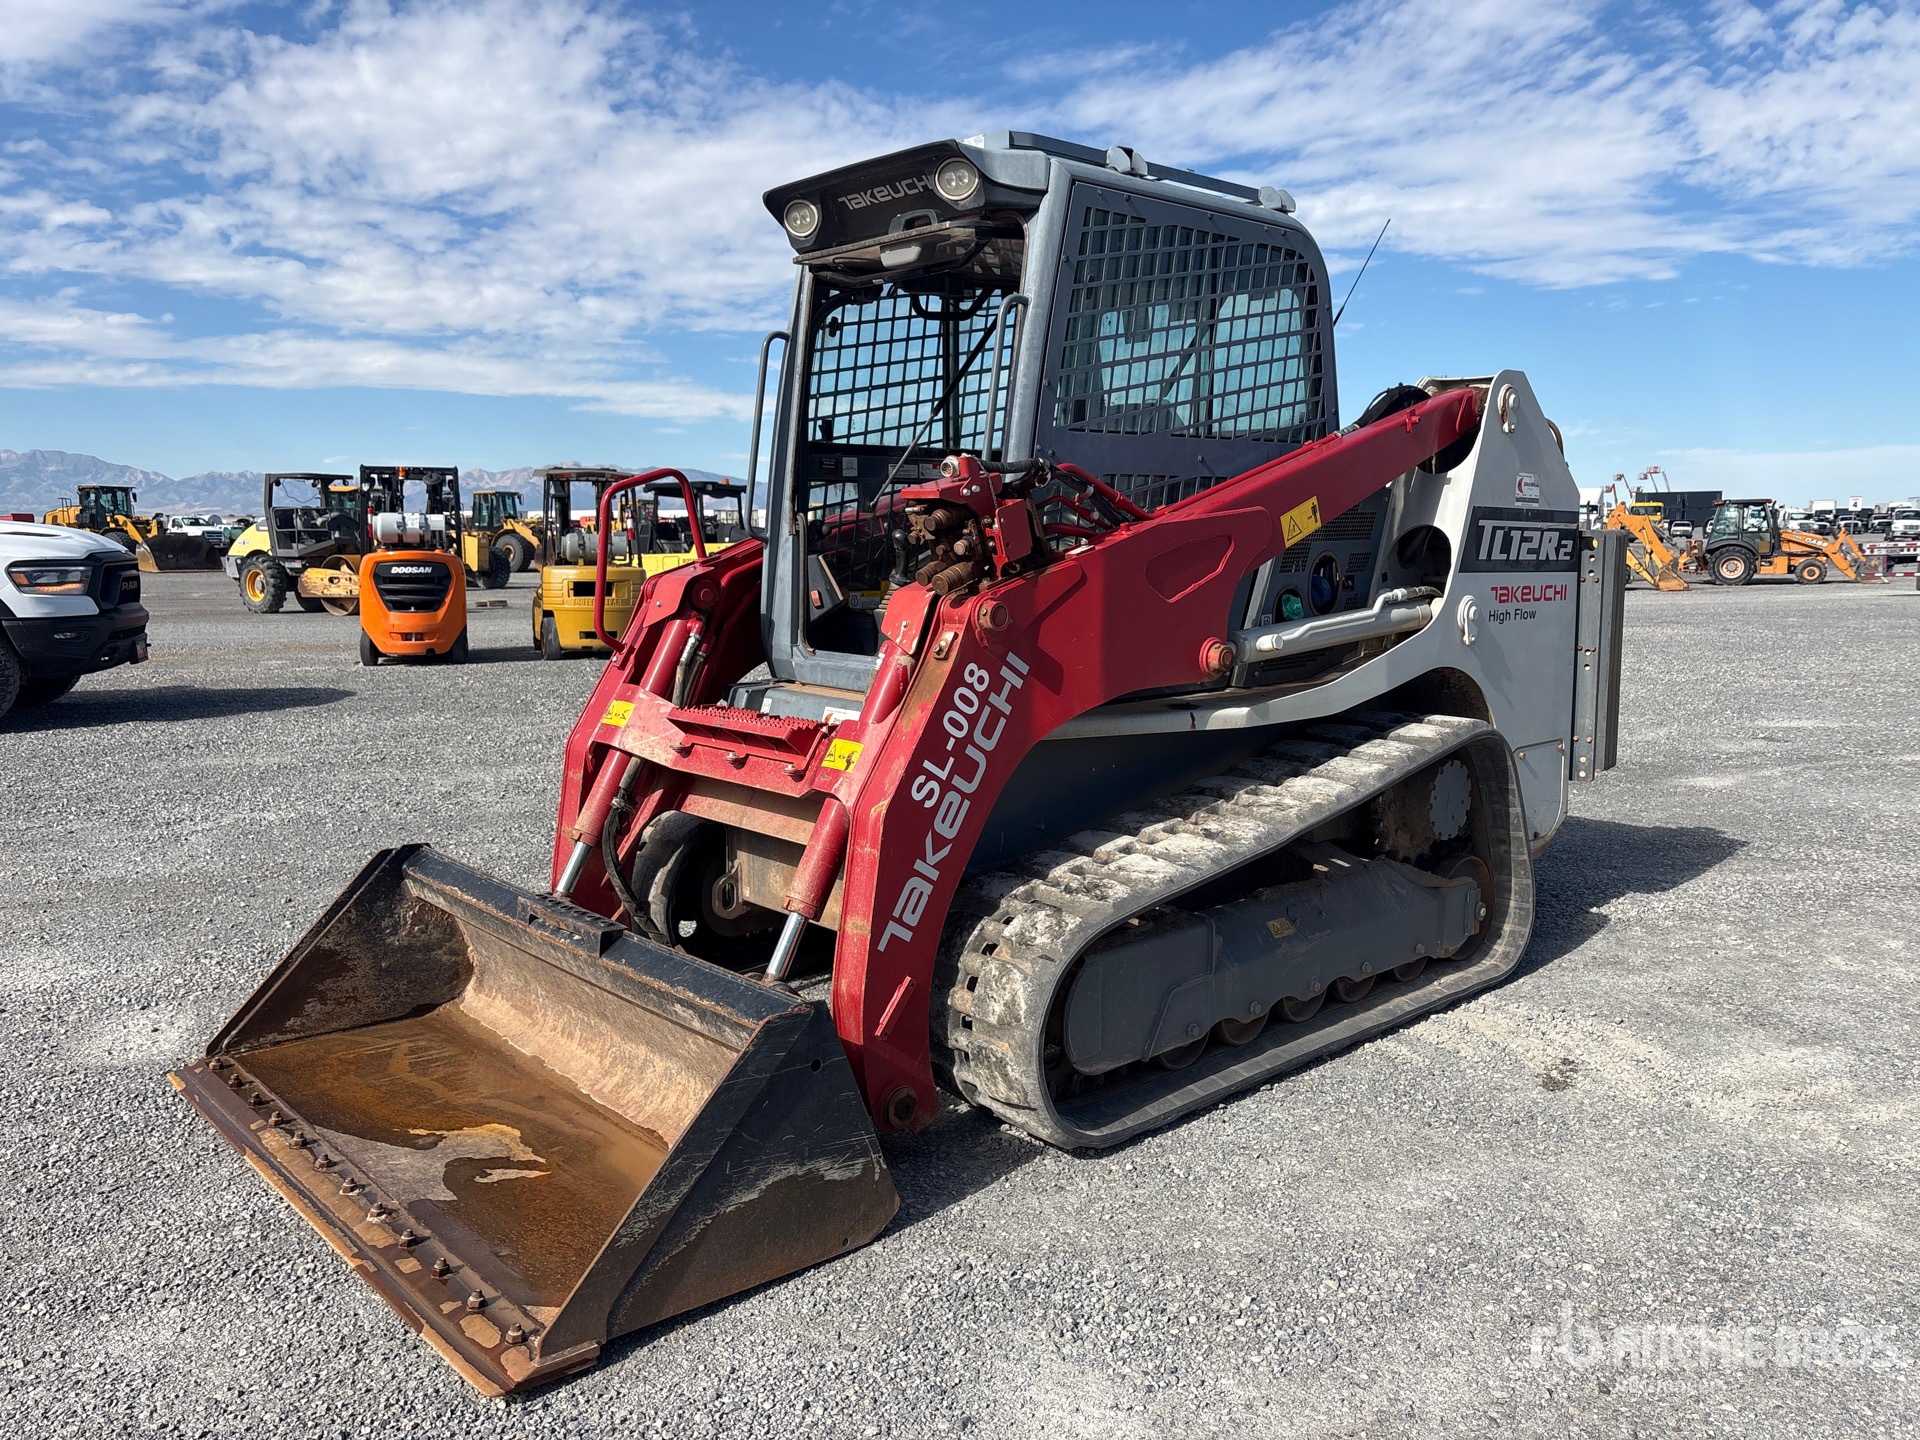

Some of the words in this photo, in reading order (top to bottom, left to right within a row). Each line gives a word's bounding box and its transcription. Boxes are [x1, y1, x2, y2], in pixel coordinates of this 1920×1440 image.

[837, 174, 934, 211] TAKEUCH
[1804, 537, 1829, 548] CASE
[390, 566, 433, 574] DOOSAN
[1488, 610, 1511, 625] High
[1514, 608, 1537, 620] Flow
[911, 662, 990, 809] SL-008
